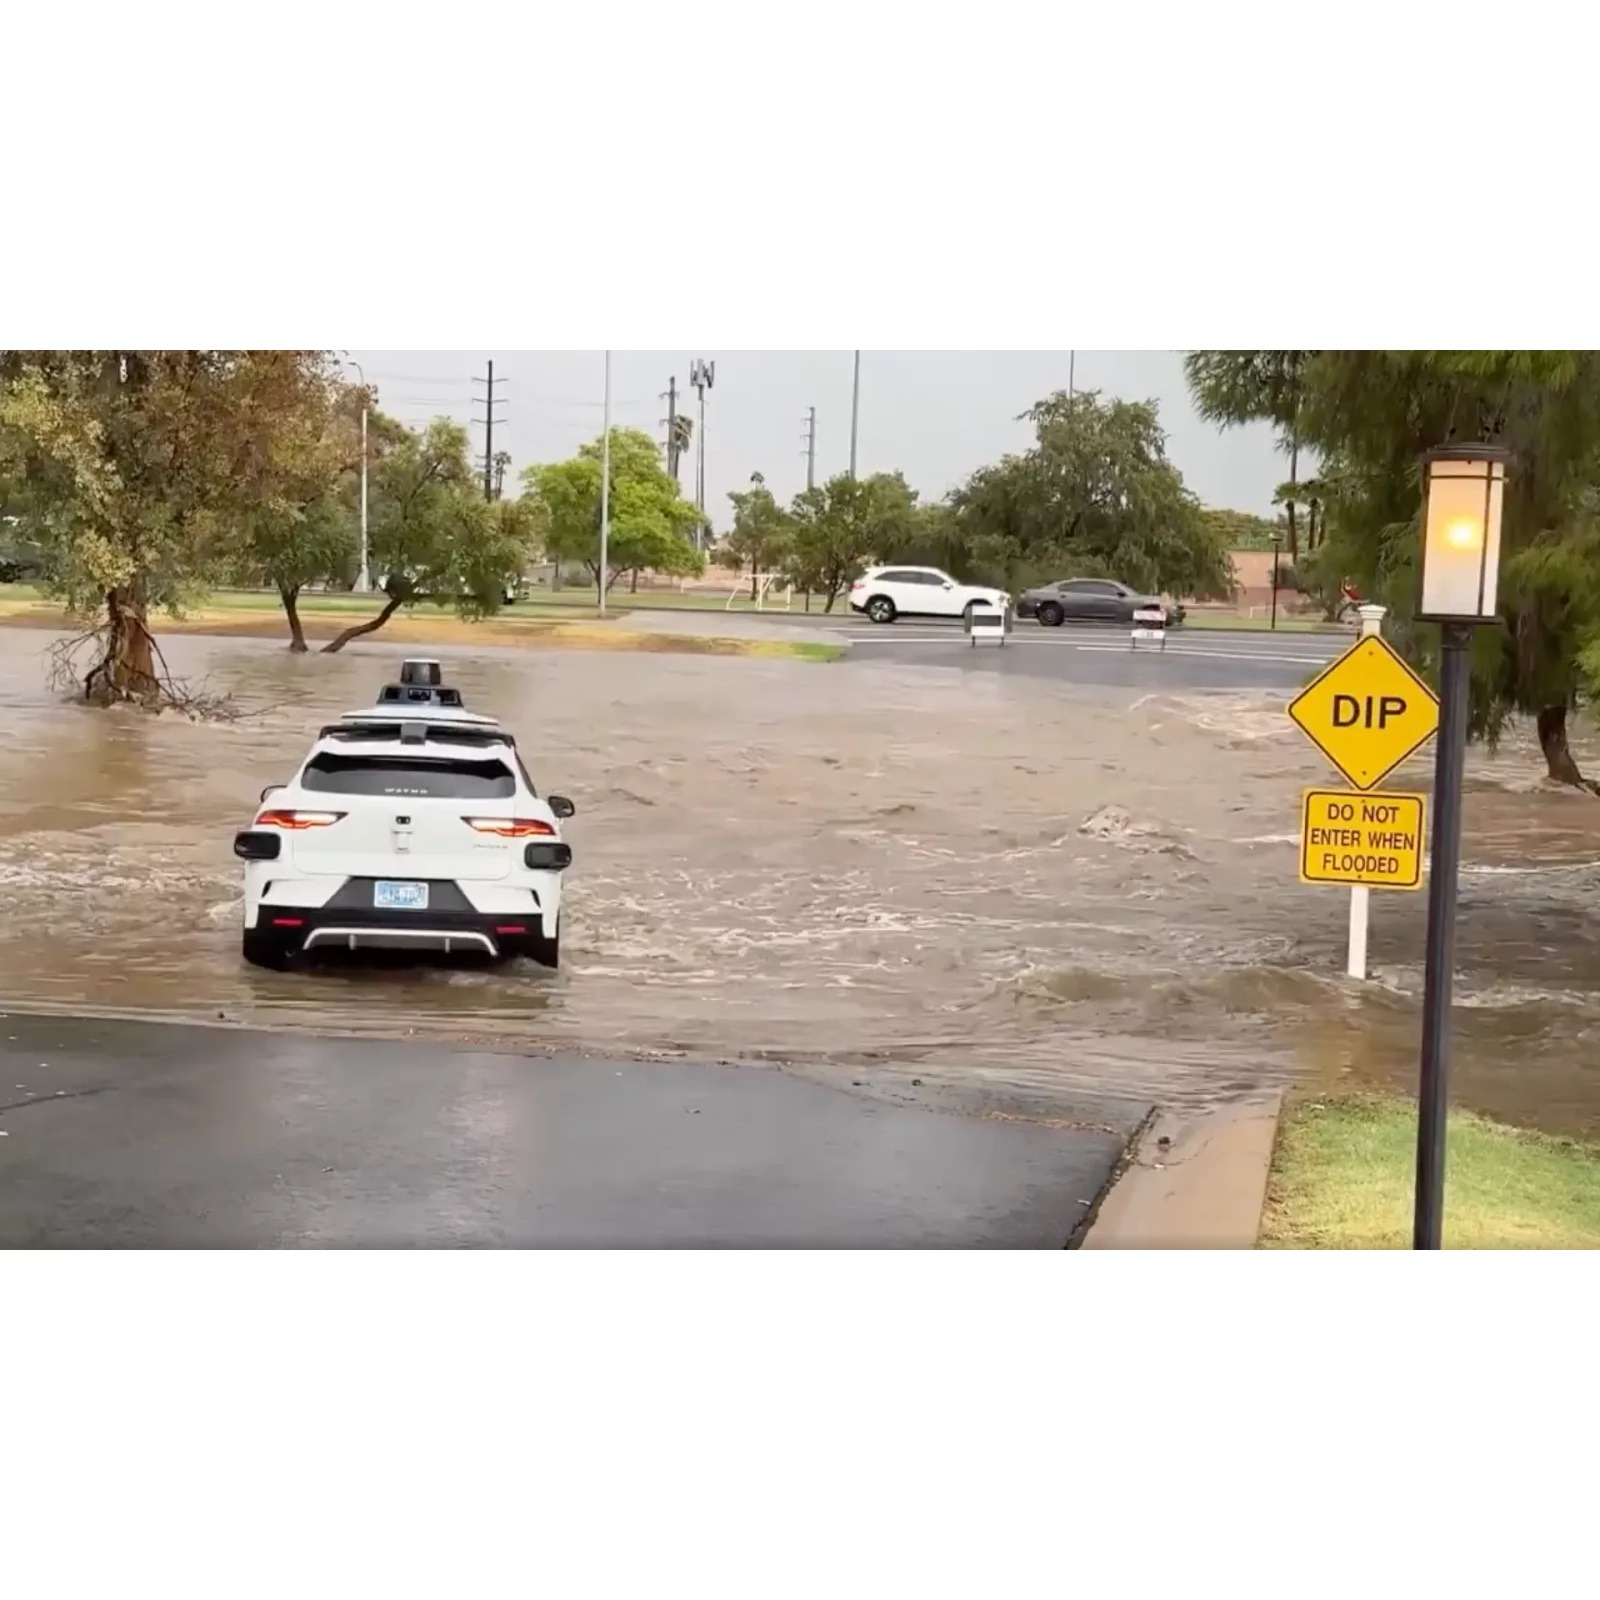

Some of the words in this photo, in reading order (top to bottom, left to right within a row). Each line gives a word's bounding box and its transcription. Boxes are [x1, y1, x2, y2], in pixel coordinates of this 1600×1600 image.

[1332, 694, 1407, 729] DIP
[1327, 803, 1354, 821] DO
[1362, 805, 1400, 824] NOT
[1310, 828, 1361, 847] ENTER
[1368, 832, 1414, 851] WHEN
[1322, 853, 1399, 874] FLOODED
